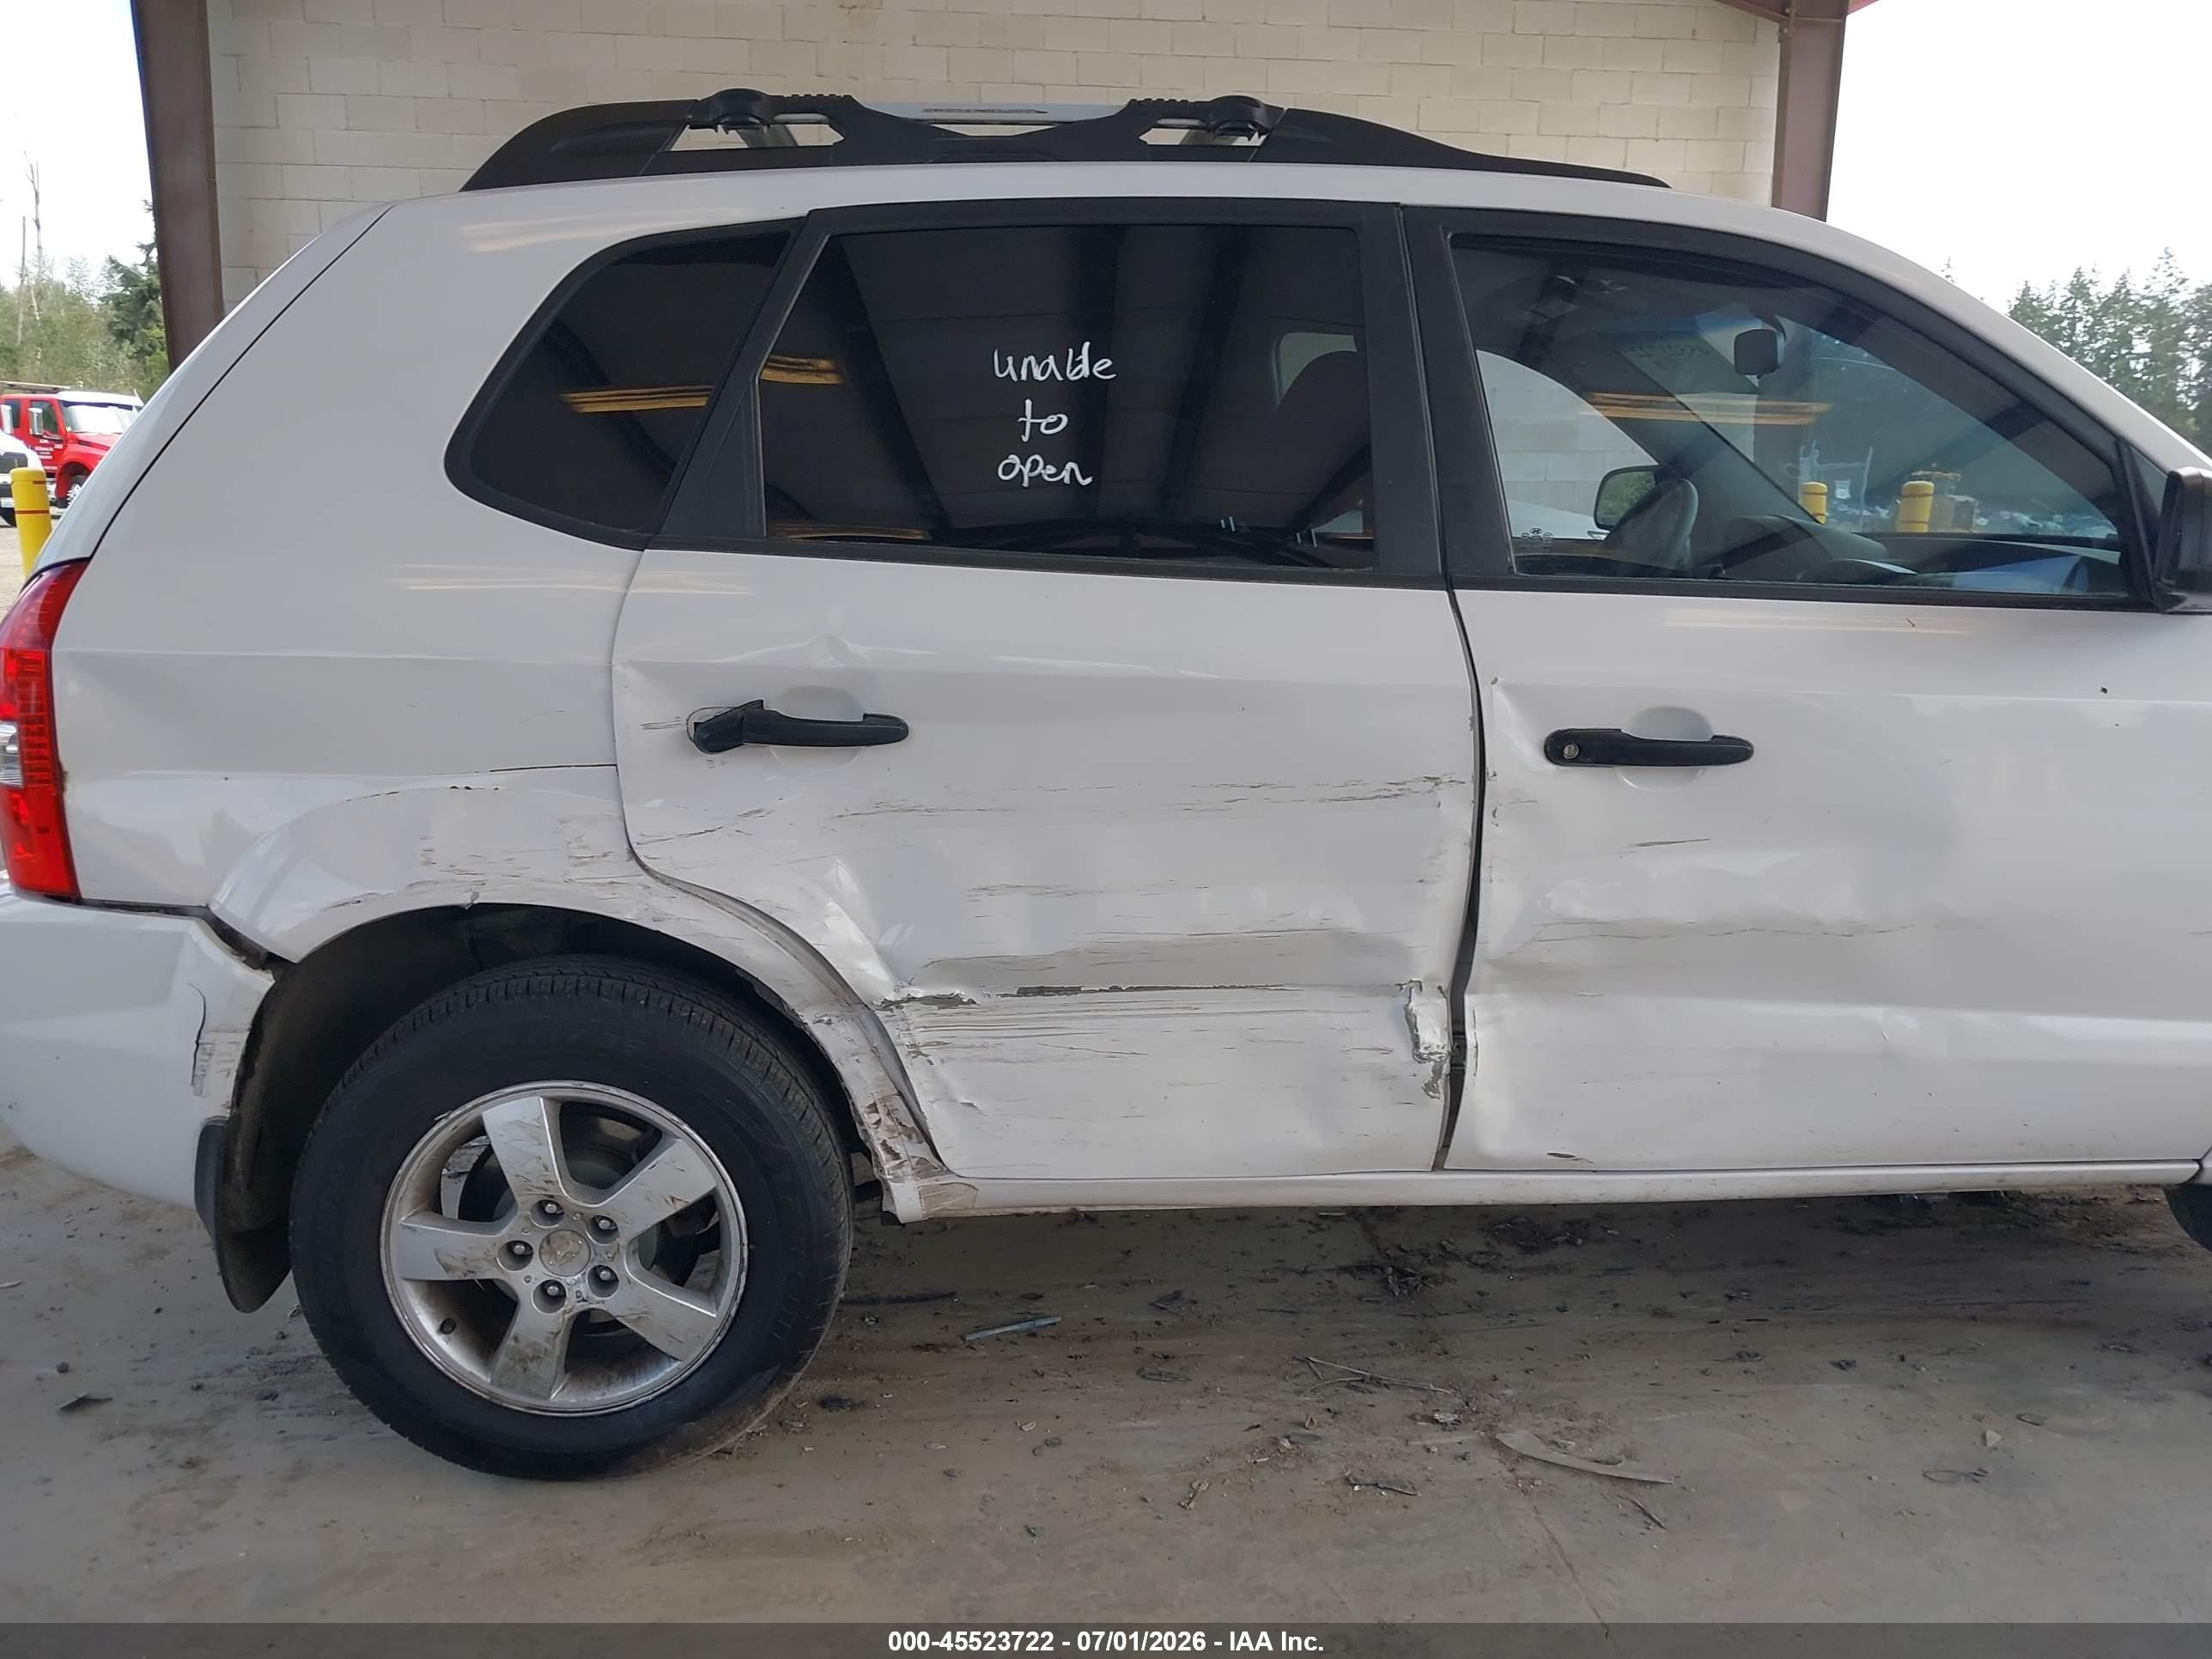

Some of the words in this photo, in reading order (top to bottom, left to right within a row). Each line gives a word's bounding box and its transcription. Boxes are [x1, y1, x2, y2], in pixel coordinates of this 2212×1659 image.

[994, 341, 1116, 382] unable
[1018, 398, 1068, 442] to
[997, 453, 1093, 488] open
